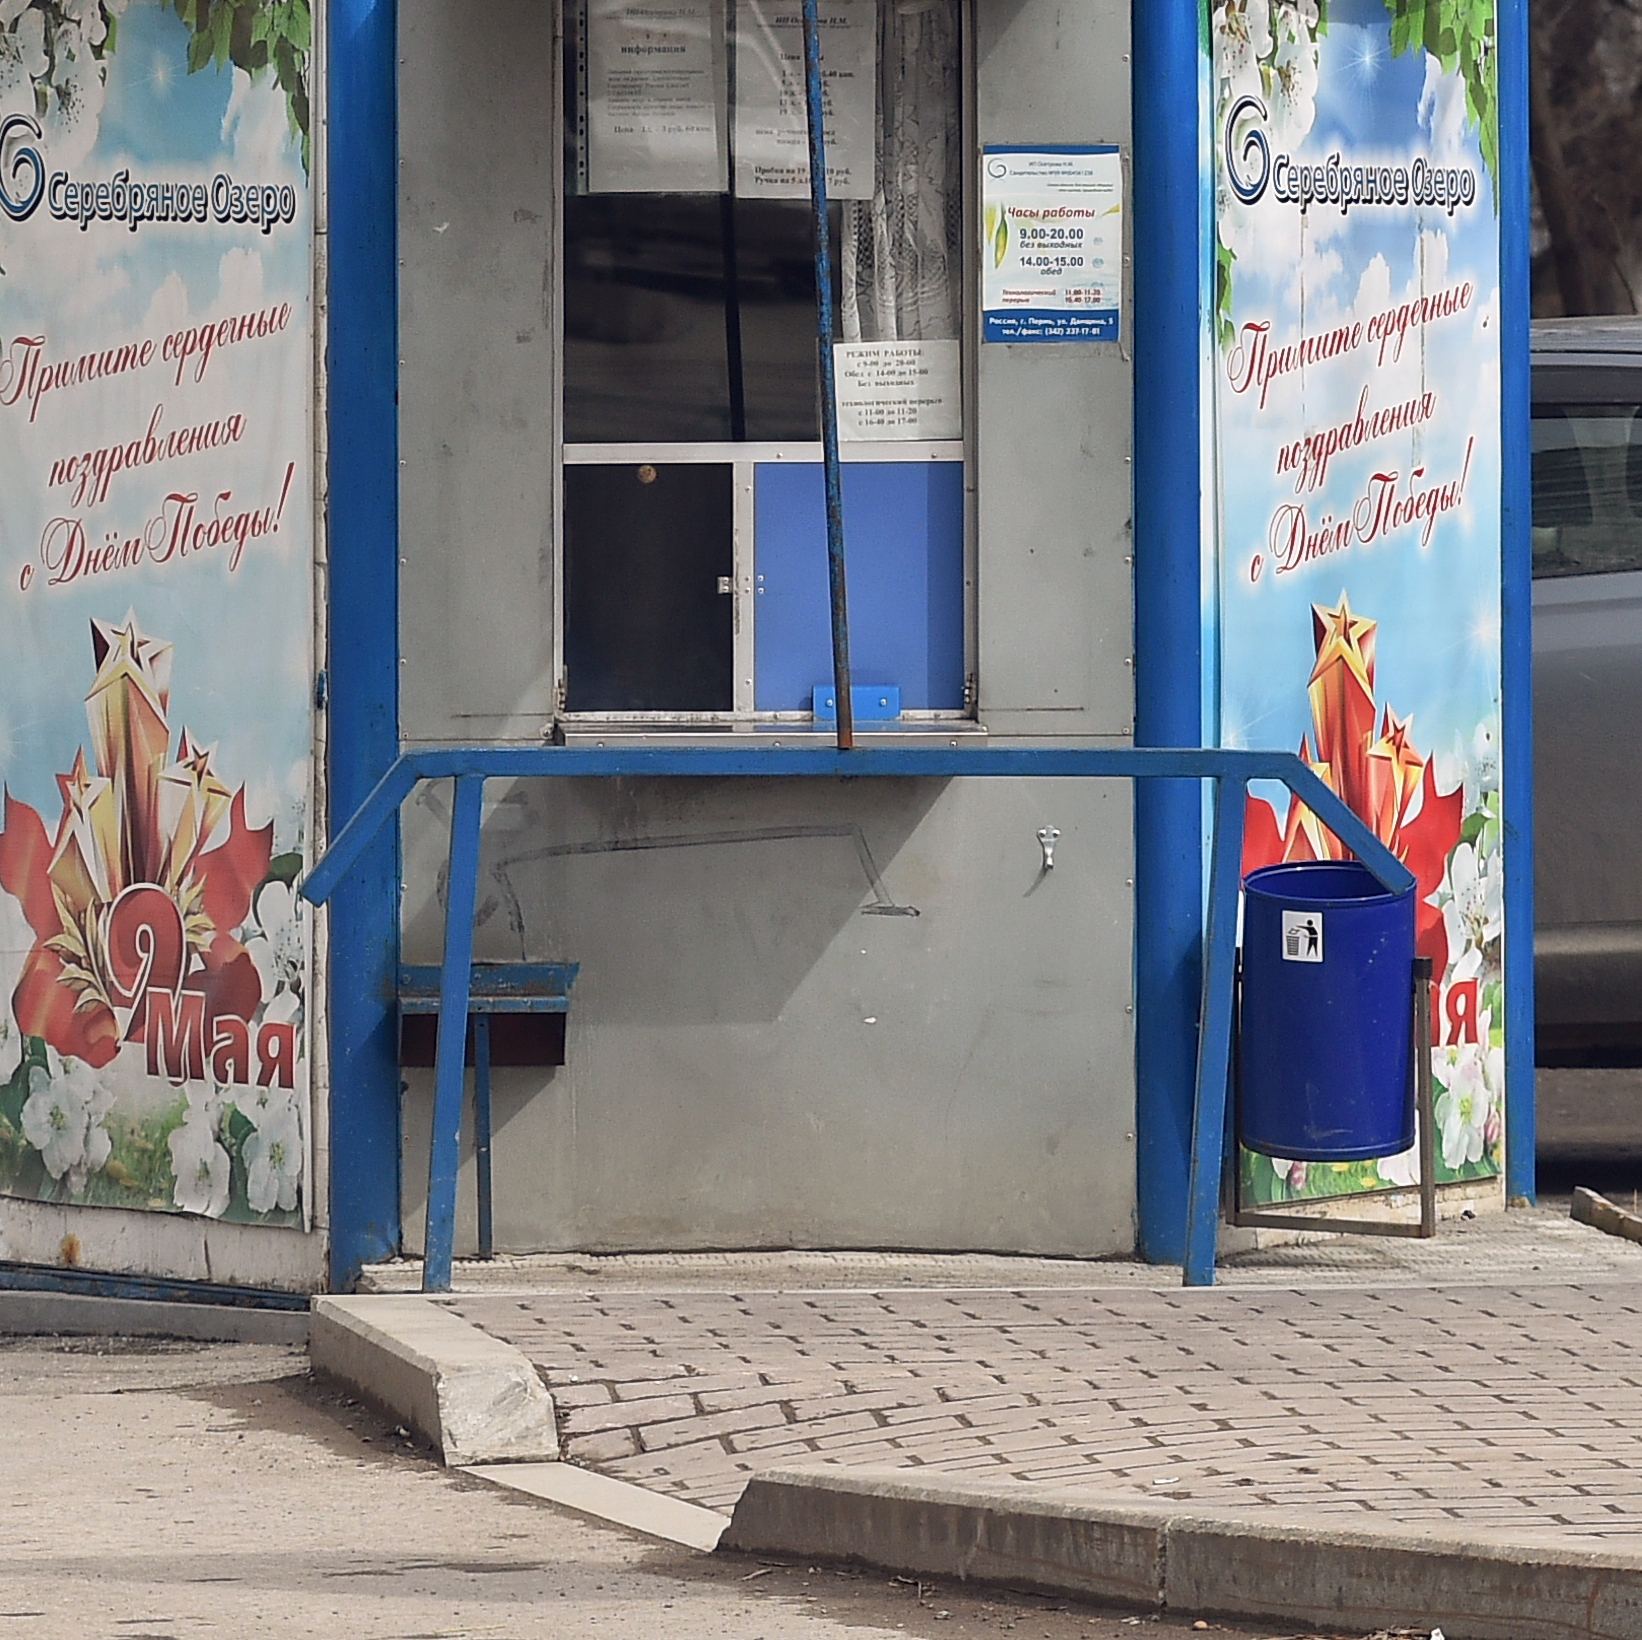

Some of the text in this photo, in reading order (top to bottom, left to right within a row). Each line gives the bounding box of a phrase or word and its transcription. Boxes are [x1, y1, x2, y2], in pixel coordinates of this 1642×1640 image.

[621, 45, 686, 55] информация
[48, 169, 295, 235] Серебряное Озеро
[1007, 206, 1096, 219] Часы работы
[1273, 152, 1475, 217] Серебряное Озеро
[1019, 228, 1084, 239] 9.00-20.00
[1019, 240, 1083, 249] без выходных
[1019, 256, 1084, 267] 14.00-15.00
[1040, 267, 1063, 276] обед
[846, 349, 880, 358] РЕЖИМ
[988, 317, 1019, 326] Россия,
[1227, 321, 1363, 410] Примите
[48, 403, 247, 508] поздравления
[1277, 384, 1437, 494] поздравления
[20, 461, 295, 591] с Днём Победы!
[1250, 436, 1474, 582] с Днём Победы!
[106, 882, 186, 1042] 9
[146, 987, 296, 1090] Мая
